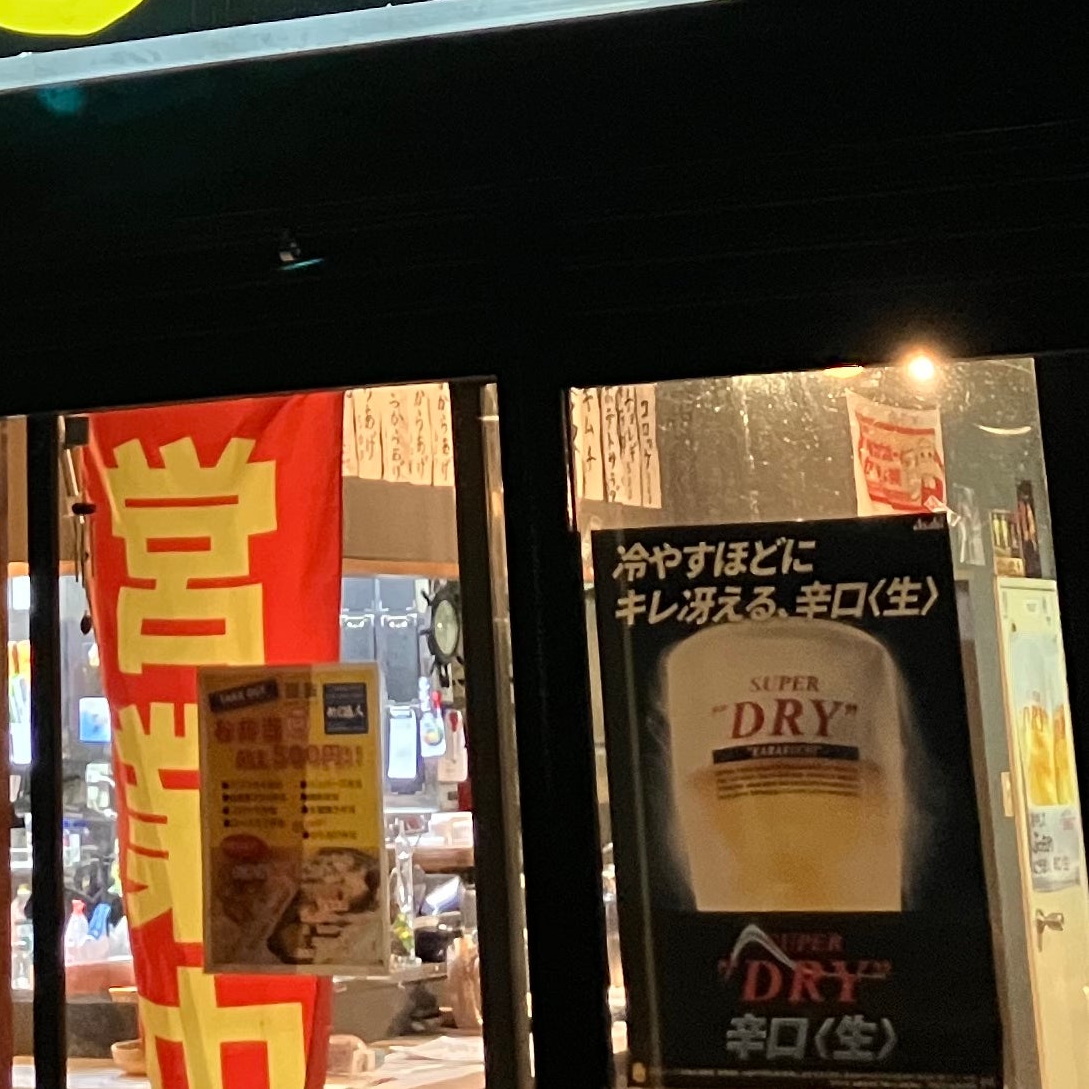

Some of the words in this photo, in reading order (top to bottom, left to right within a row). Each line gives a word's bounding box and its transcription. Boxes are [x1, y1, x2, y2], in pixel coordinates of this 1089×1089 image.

[612, 536, 817, 582] 冷やすほどに
[750, 675, 819, 692] SUPER
[770, 932, 844, 952] UPER
